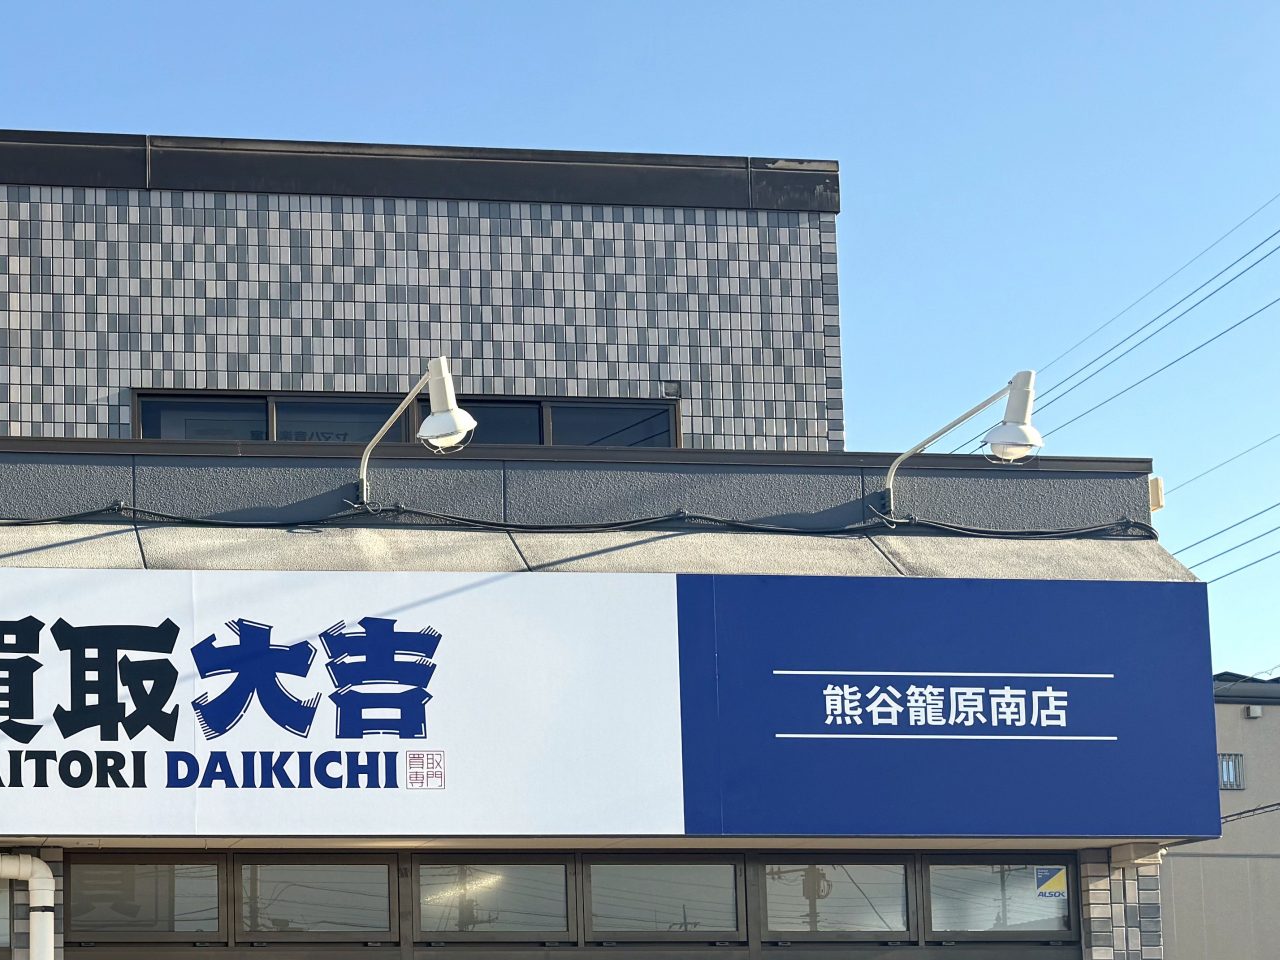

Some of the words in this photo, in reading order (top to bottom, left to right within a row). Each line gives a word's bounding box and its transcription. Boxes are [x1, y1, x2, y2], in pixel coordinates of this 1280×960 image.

[823, 684, 1067, 727] 熊谷籠原南店
[165, 750, 399, 788] DAIKICHI
